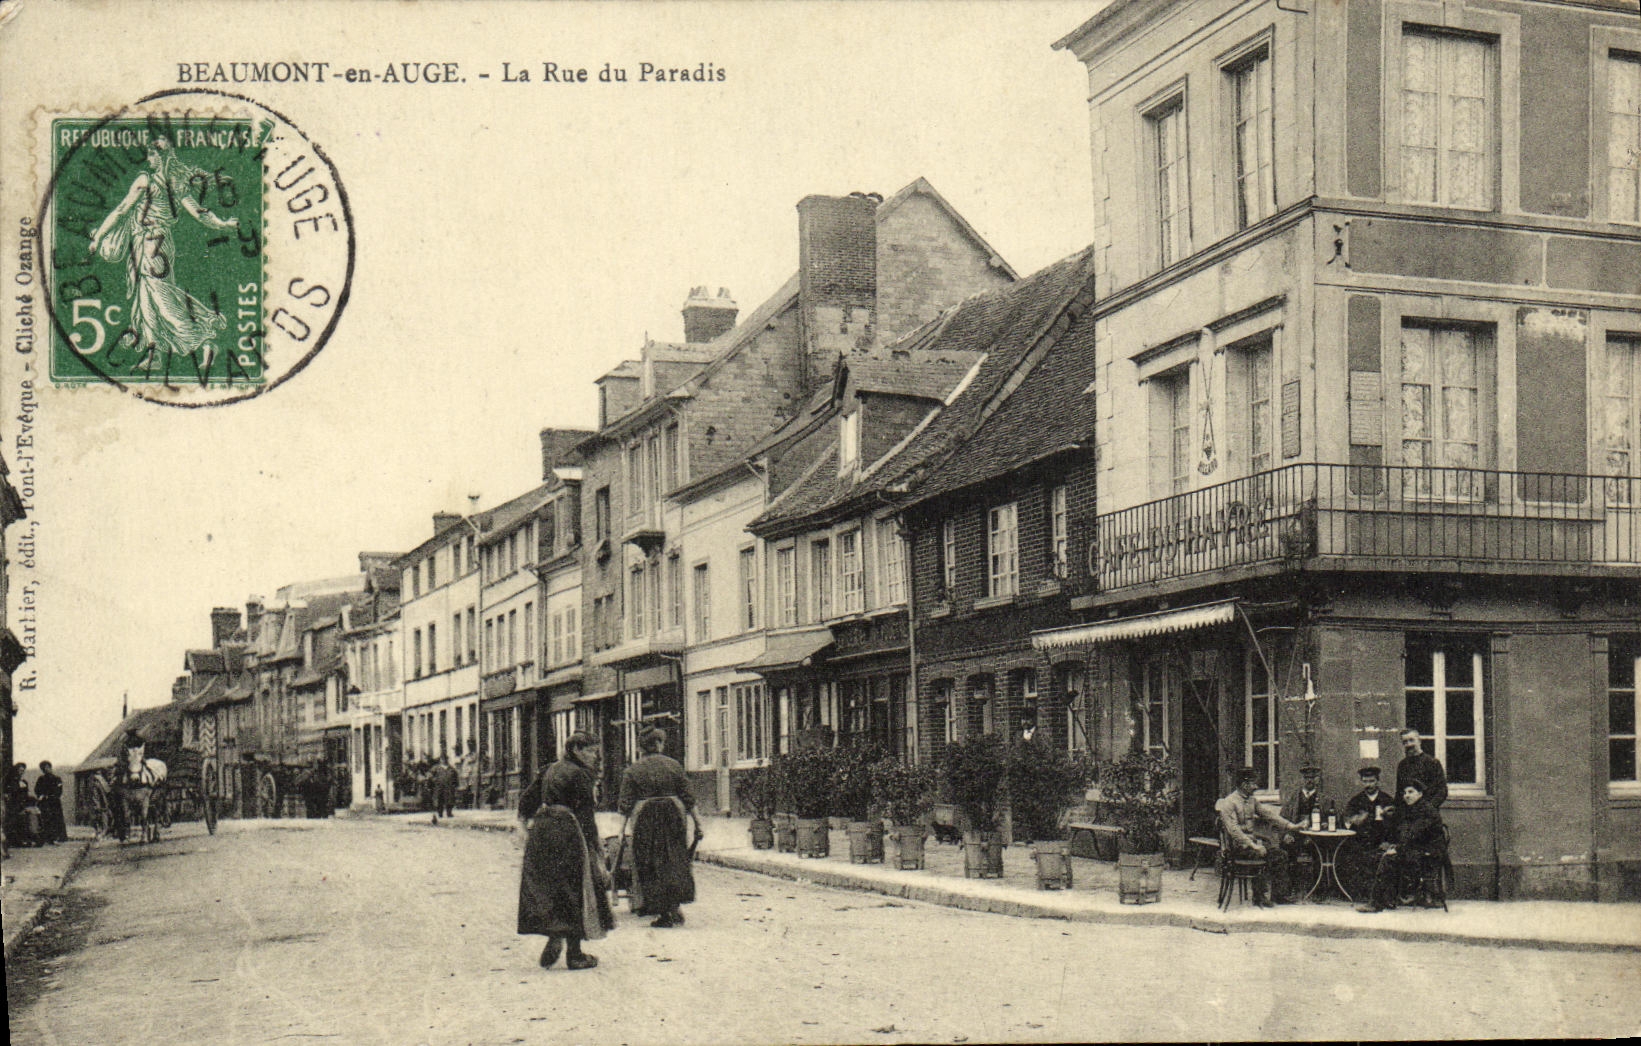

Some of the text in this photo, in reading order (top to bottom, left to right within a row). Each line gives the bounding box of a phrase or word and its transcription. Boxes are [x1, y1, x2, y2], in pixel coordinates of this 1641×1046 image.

[238, 282, 257, 366] POSTES
[1150, 526, 1180, 564] DU
[1185, 498, 1271, 556] HAVRE
